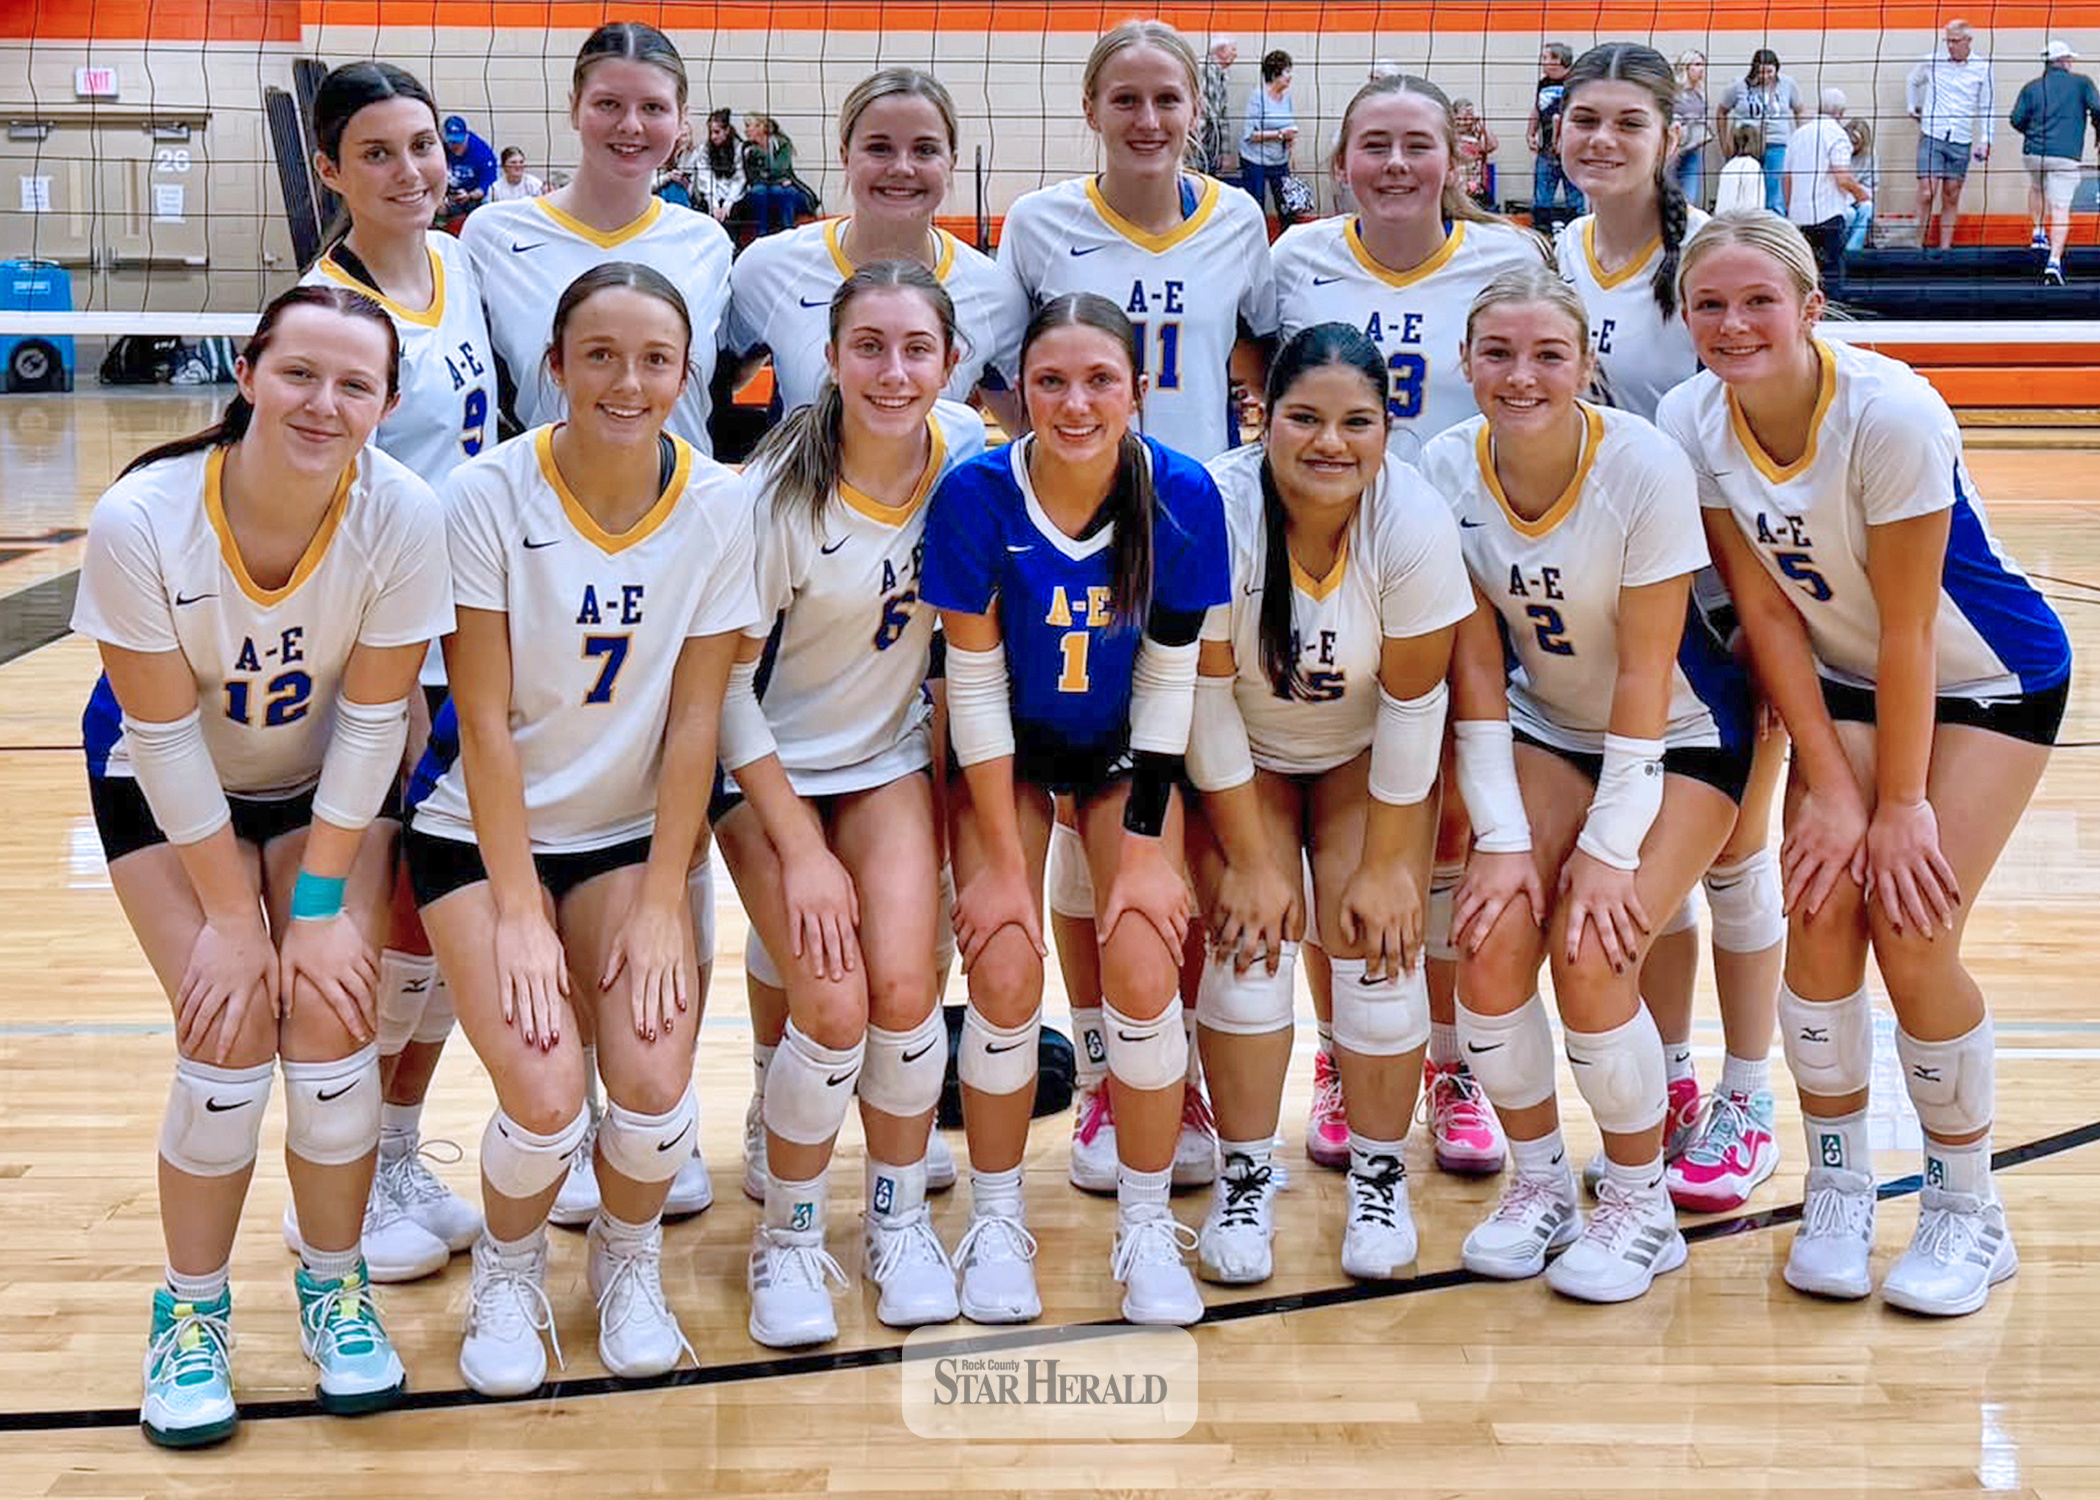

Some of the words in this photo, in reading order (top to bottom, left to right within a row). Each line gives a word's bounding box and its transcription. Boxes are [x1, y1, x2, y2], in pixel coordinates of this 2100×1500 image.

[84, 71, 111, 91] EXIT
[1126, 279, 1184, 313] A-E
[1364, 311, 1423, 343] A-E
[1591, 318, 1616, 354] -E
[444, 341, 485, 391] A-E
[460, 386, 489, 459] 9
[1757, 512, 1812, 547] A-E
[1509, 564, 1565, 600] A-E
[1775, 551, 1834, 602] 5
[576, 584, 644, 625] A-E
[873, 590, 916, 651] 6
[1045, 586, 1112, 627] A-E
[235, 626, 303, 672] A-E
[1525, 604, 1576, 656] 2
[581, 632, 634, 706] 7
[1058, 631, 1090, 693] 1
[222, 670, 313, 727] 12
